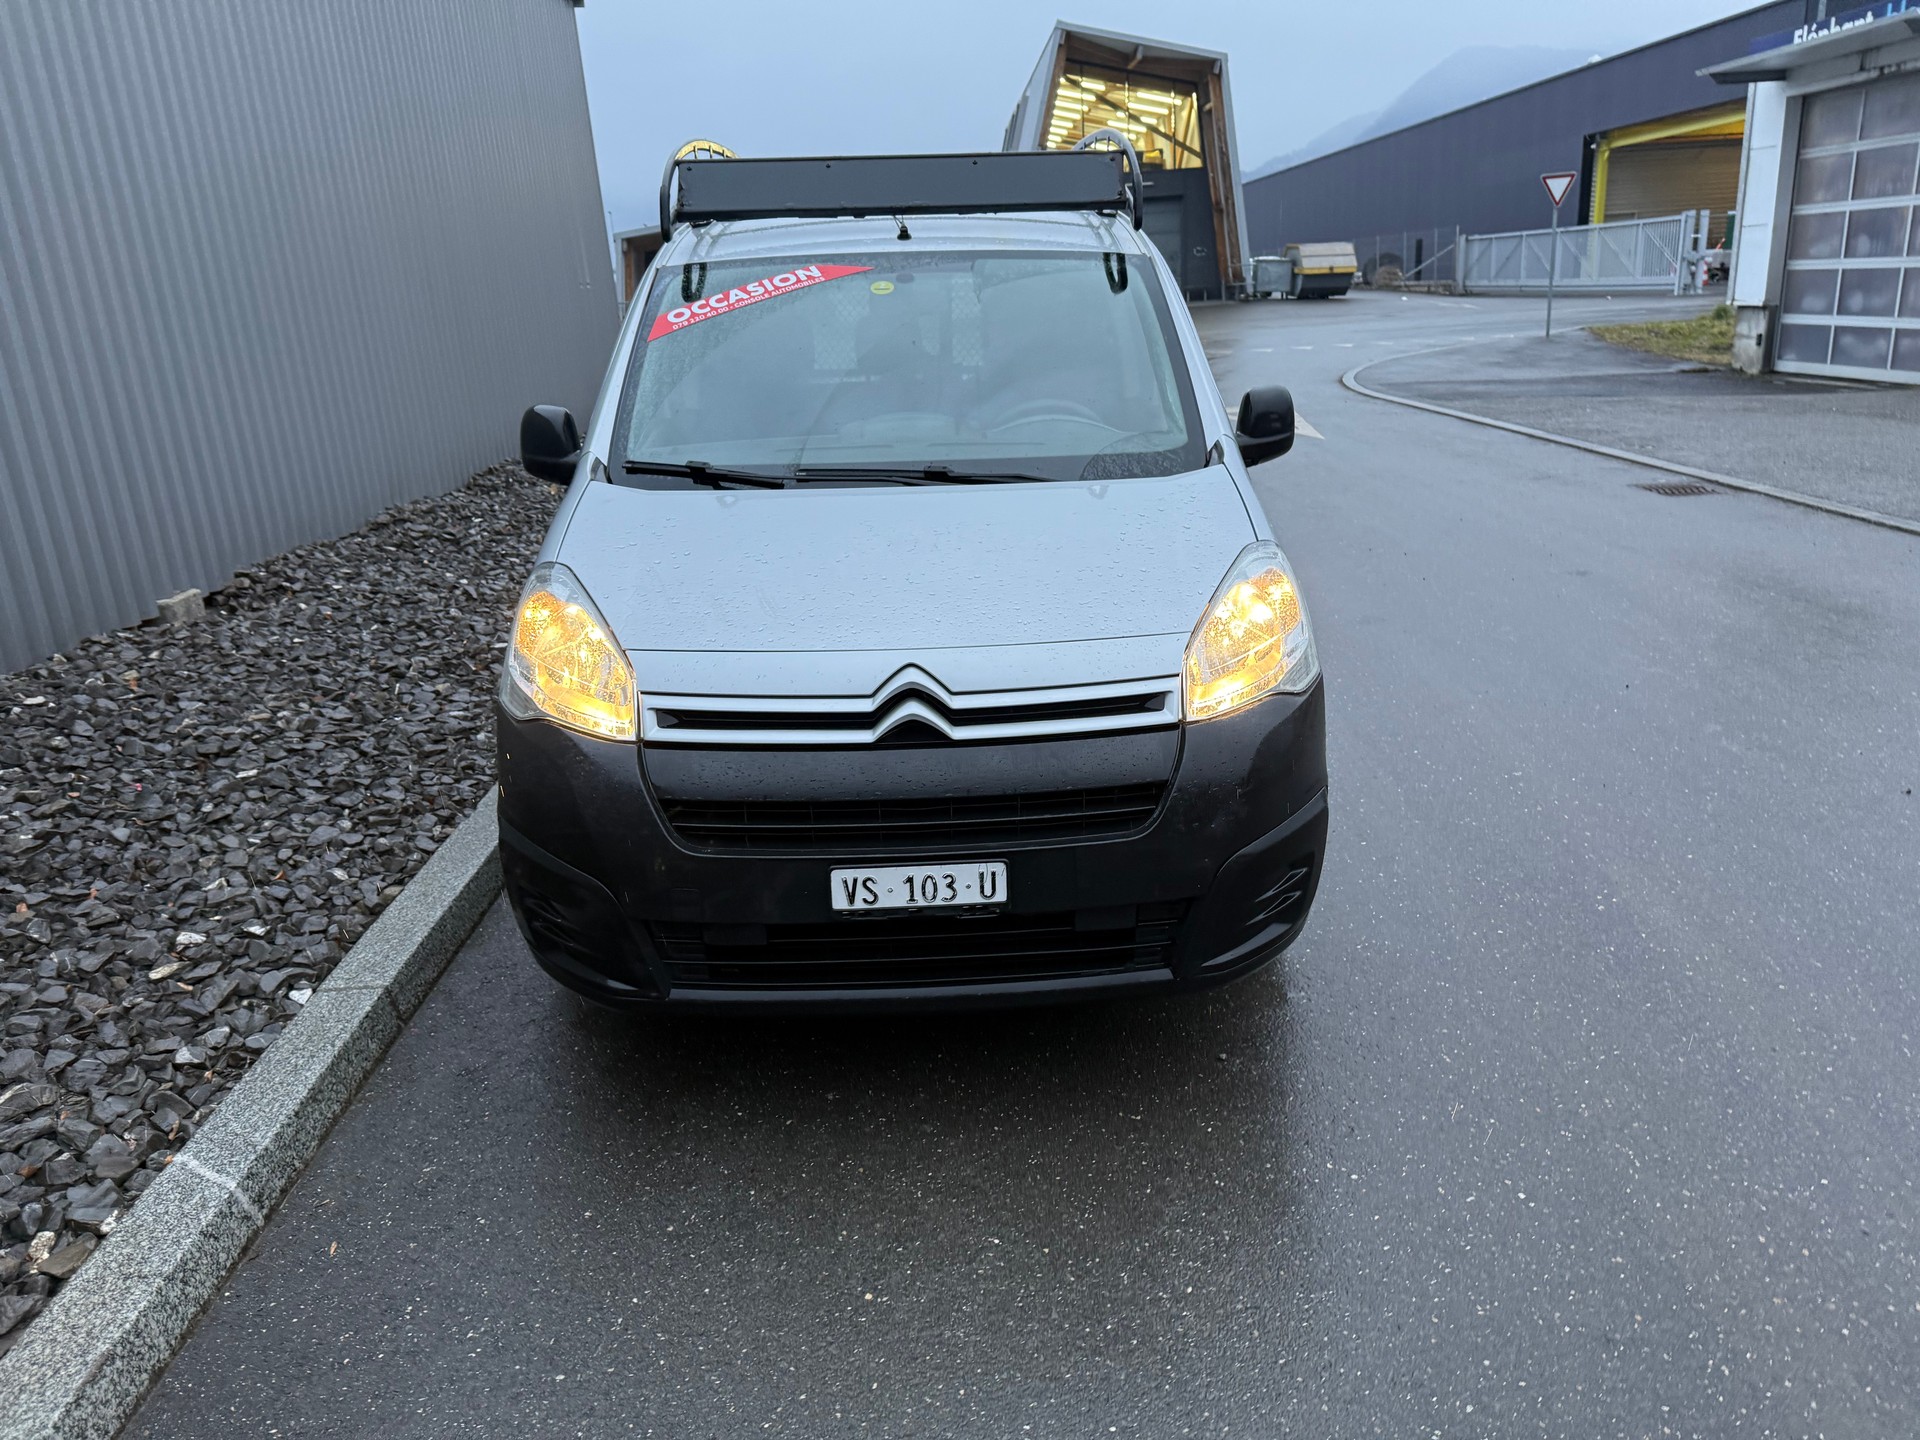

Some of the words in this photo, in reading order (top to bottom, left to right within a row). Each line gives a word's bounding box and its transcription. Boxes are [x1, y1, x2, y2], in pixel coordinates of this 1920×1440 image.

[667, 265, 822, 324] OCCASION
[672, 320, 689, 330] 079
[689, 314, 705, 324] 220
[706, 310, 717, 318] 40
[717, 306, 729, 314] 00
[734, 293, 770, 308] CONSOLE
[771, 277, 825, 297] AUTOMOBILES
[842, 877, 879, 906] VS
[903, 873, 957, 904] 103
[978, 870, 997, 900] U
